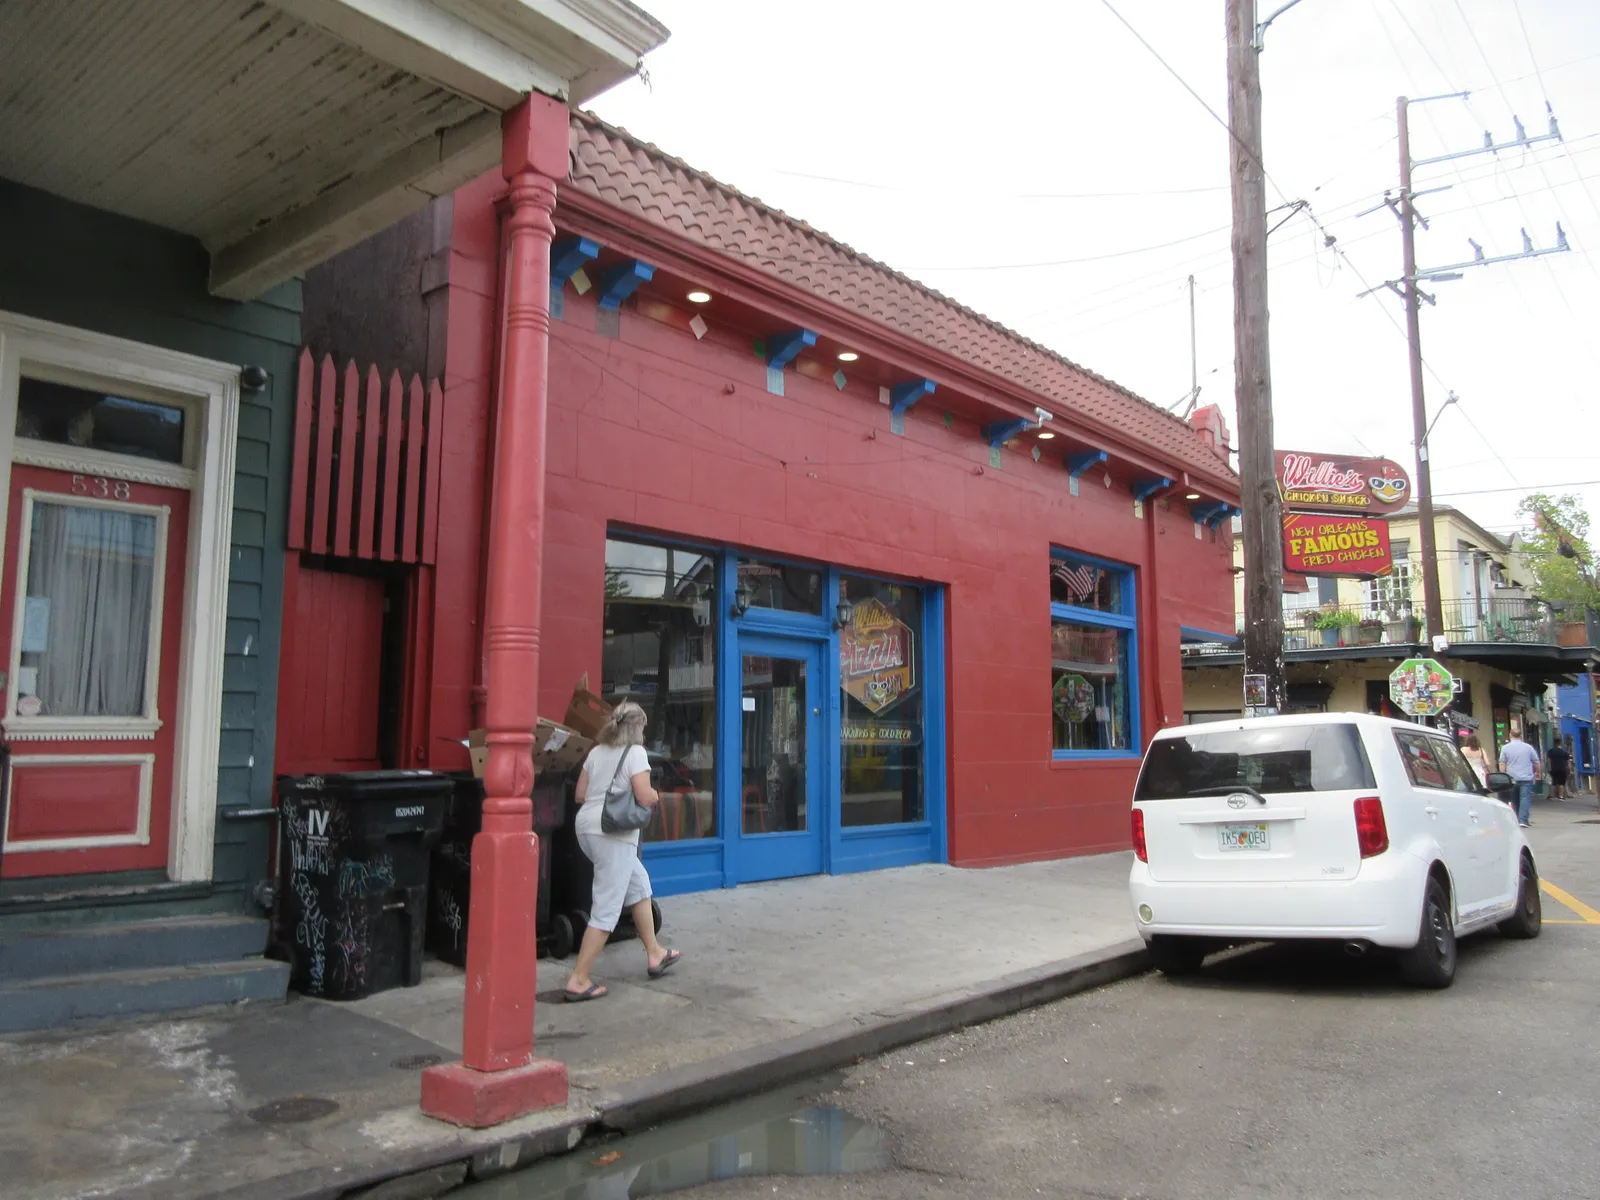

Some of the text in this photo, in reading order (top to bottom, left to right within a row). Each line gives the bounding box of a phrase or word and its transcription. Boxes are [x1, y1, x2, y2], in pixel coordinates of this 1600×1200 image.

[1283, 454, 1365, 492] Willie's
[71, 474, 130, 500] 538
[1284, 491, 1369, 506] CHICKEN SHACK
[1291, 520, 1368, 538] NEW ORLEANS
[1289, 529, 1380, 556] FAMOUS
[1301, 547, 1385, 567] FRIED CHICKEN
[856, 604, 894, 630] Willie's
